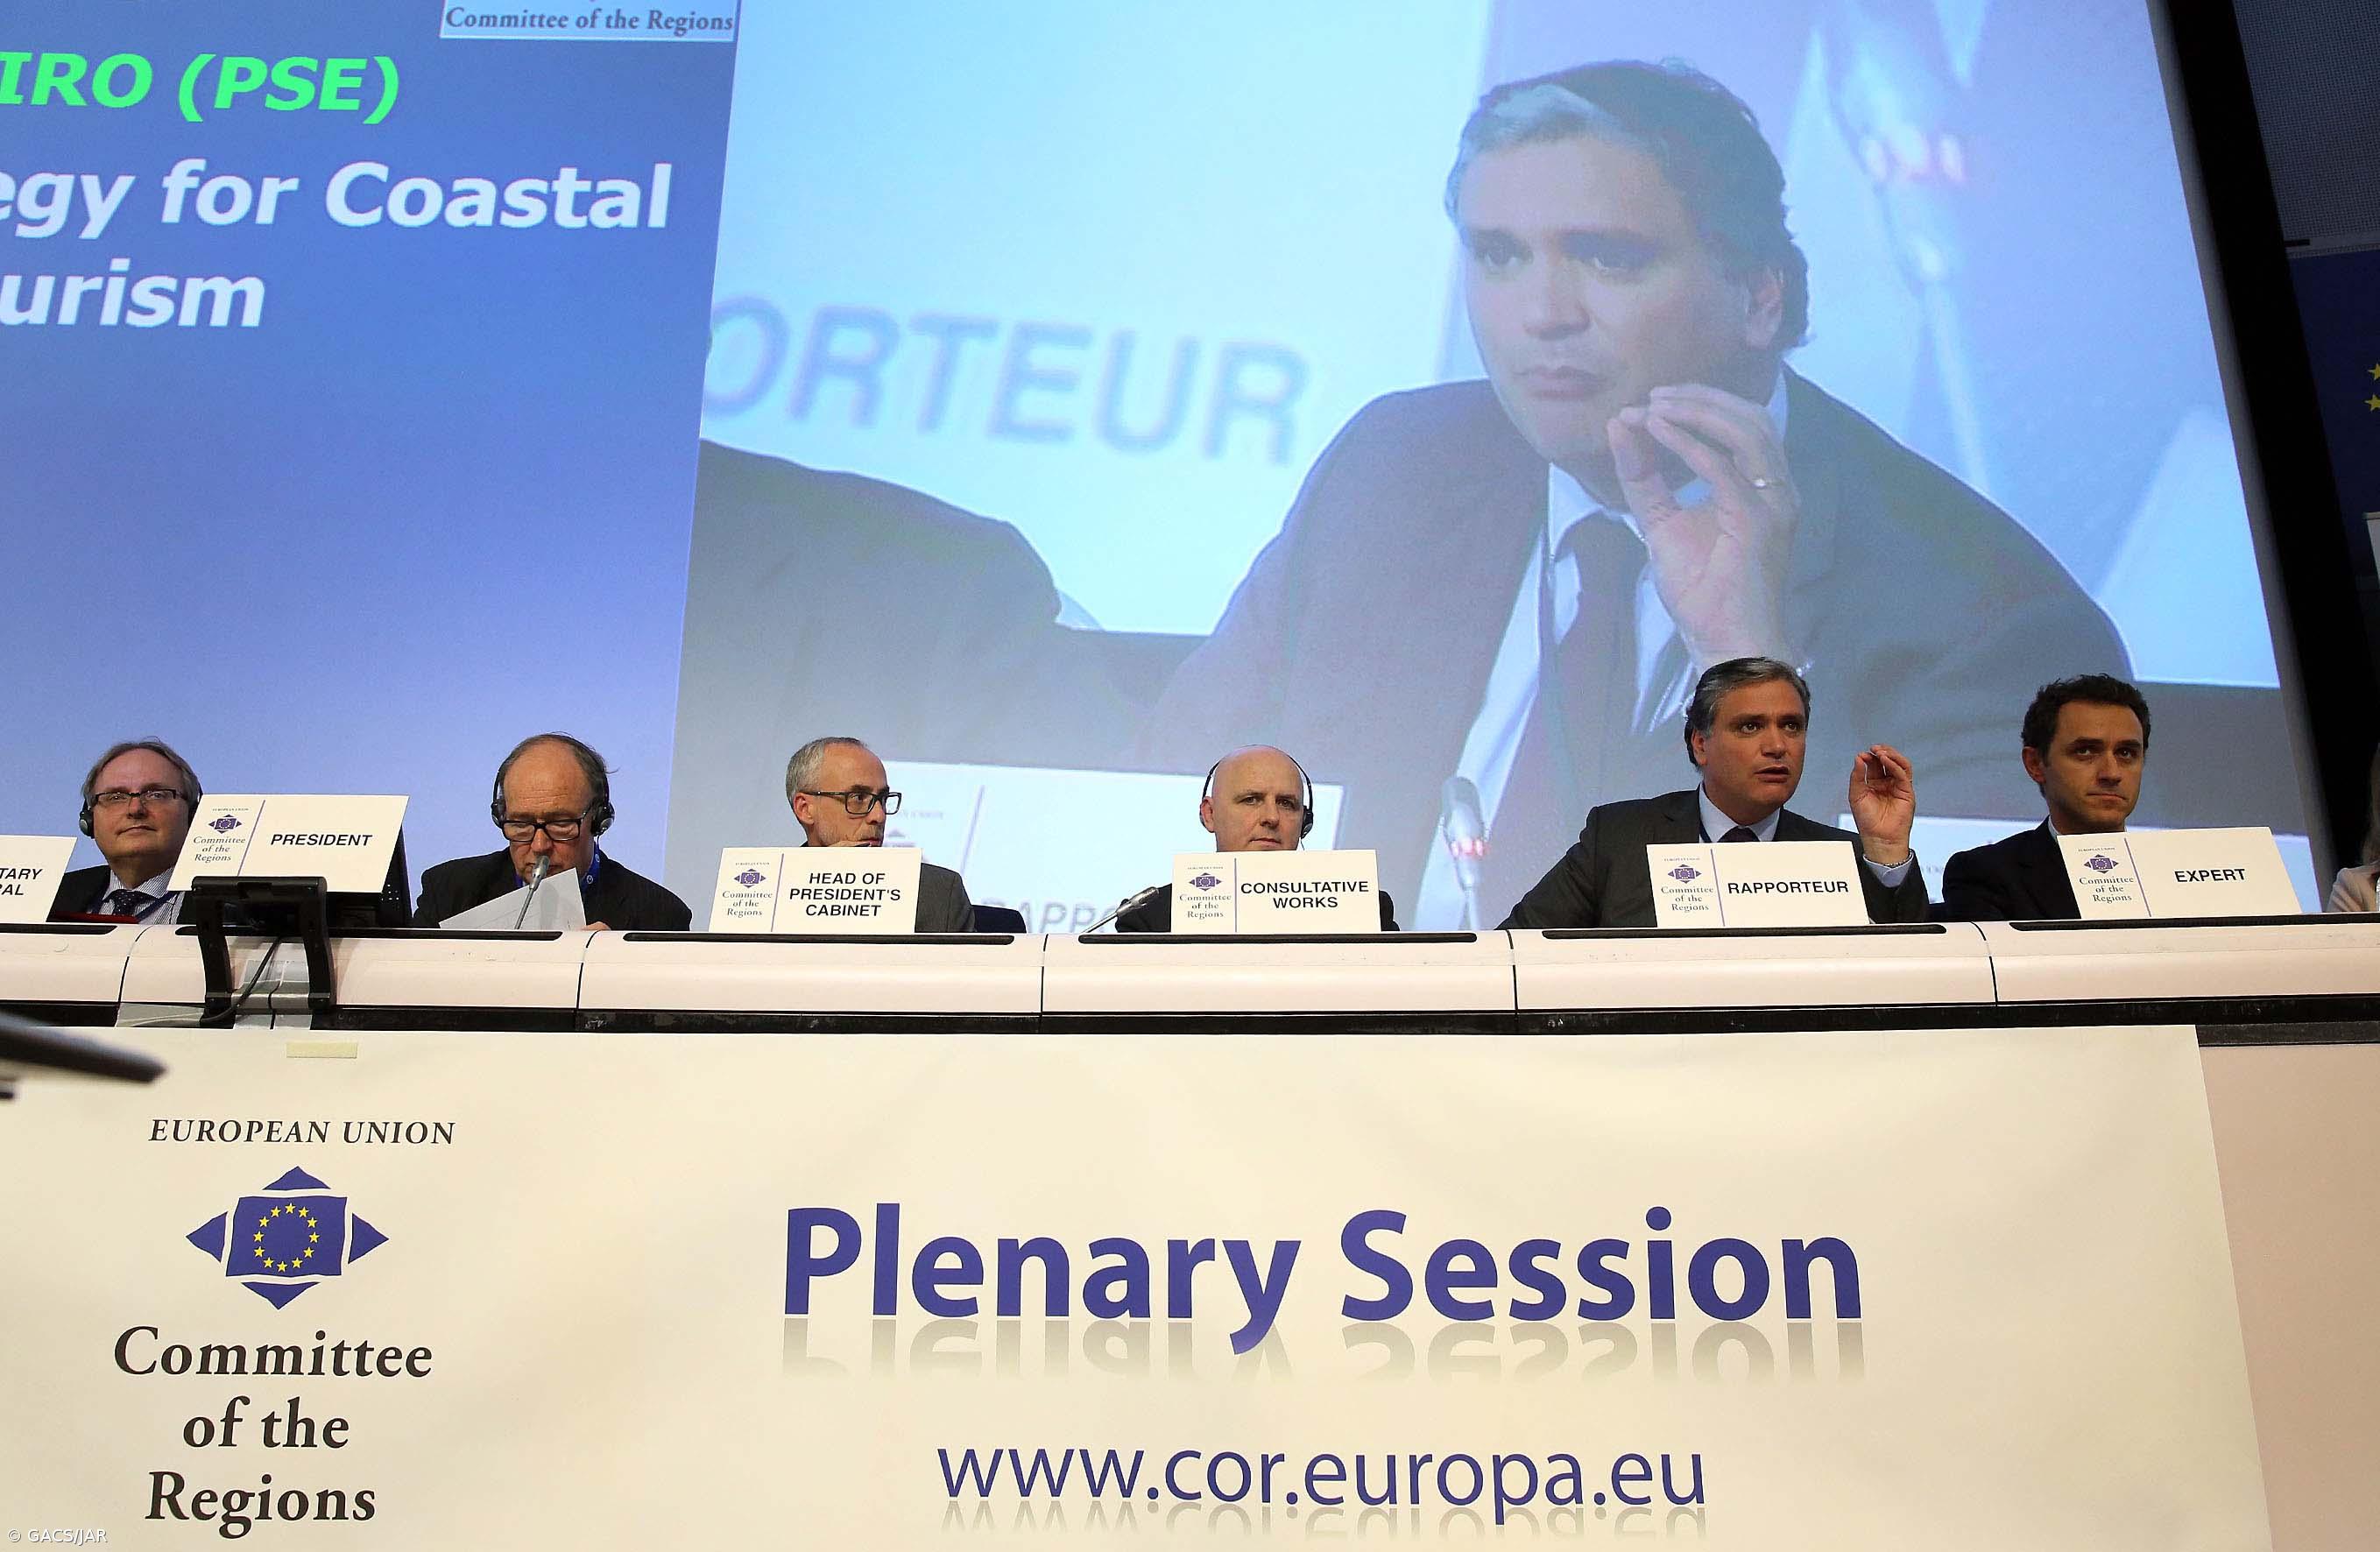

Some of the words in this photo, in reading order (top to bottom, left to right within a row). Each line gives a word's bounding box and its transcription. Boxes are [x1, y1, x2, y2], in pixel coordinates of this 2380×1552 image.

[446, 6, 569, 29] Committee
[576, 8, 604, 30] of
[605, 8, 639, 30] the
[647, 10, 733, 37] Regions
[0, 51, 153, 109] IRO
[178, 53, 399, 124] (PSE)
[161, 159, 300, 225] for
[326, 161, 672, 229] Coastal
[0, 257, 265, 328] urism
[703, 296, 1310, 466] ORTEUR
[193, 836, 246, 845] Committee
[270, 833, 373, 847] PRESIDENT
[215, 844, 230, 853] the
[194, 853, 231, 864] Regions
[809, 872, 857, 885] HEAD
[862, 872, 886, 885] OF
[2079, 876, 2135, 886] Committee
[2174, 868, 2246, 883] EXPERT
[0, 884, 25, 896] AL
[1240, 880, 1369, 894] CONSULTATIVE
[1660, 885, 1714, 894] Committee
[1727, 880, 1849, 894] RAPPORTEUR
[2108, 885, 2125, 893] the
[722, 890, 773, 899] Committee
[789, 888, 901, 901] PRESIDENT'S
[1179, 893, 1232, 902] Committee
[2092, 893, 2133, 905] Regions
[732, 899, 744, 907] of
[745, 899, 759, 907] the
[1273, 896, 1338, 909] WORKS
[1670, 903, 1710, 913] Regions
[726, 907, 763, 919] Regions
[805, 904, 882, 917] CABINET
[1187, 910, 1224, 921] Regions
[147, 1118, 331, 1144] EUROPEAN
[343, 1121, 456, 1145] UNION
[784, 1203, 1303, 1355] Plenary
[1340, 1206, 1862, 1322] Session
[114, 1325, 433, 1378] Committee
[183, 1395, 251, 1448] of
[260, 1395, 350, 1450] the
[936, 1447, 1706, 1526] www.cor.europa.eu
[144, 1471, 377, 1540] Regions
